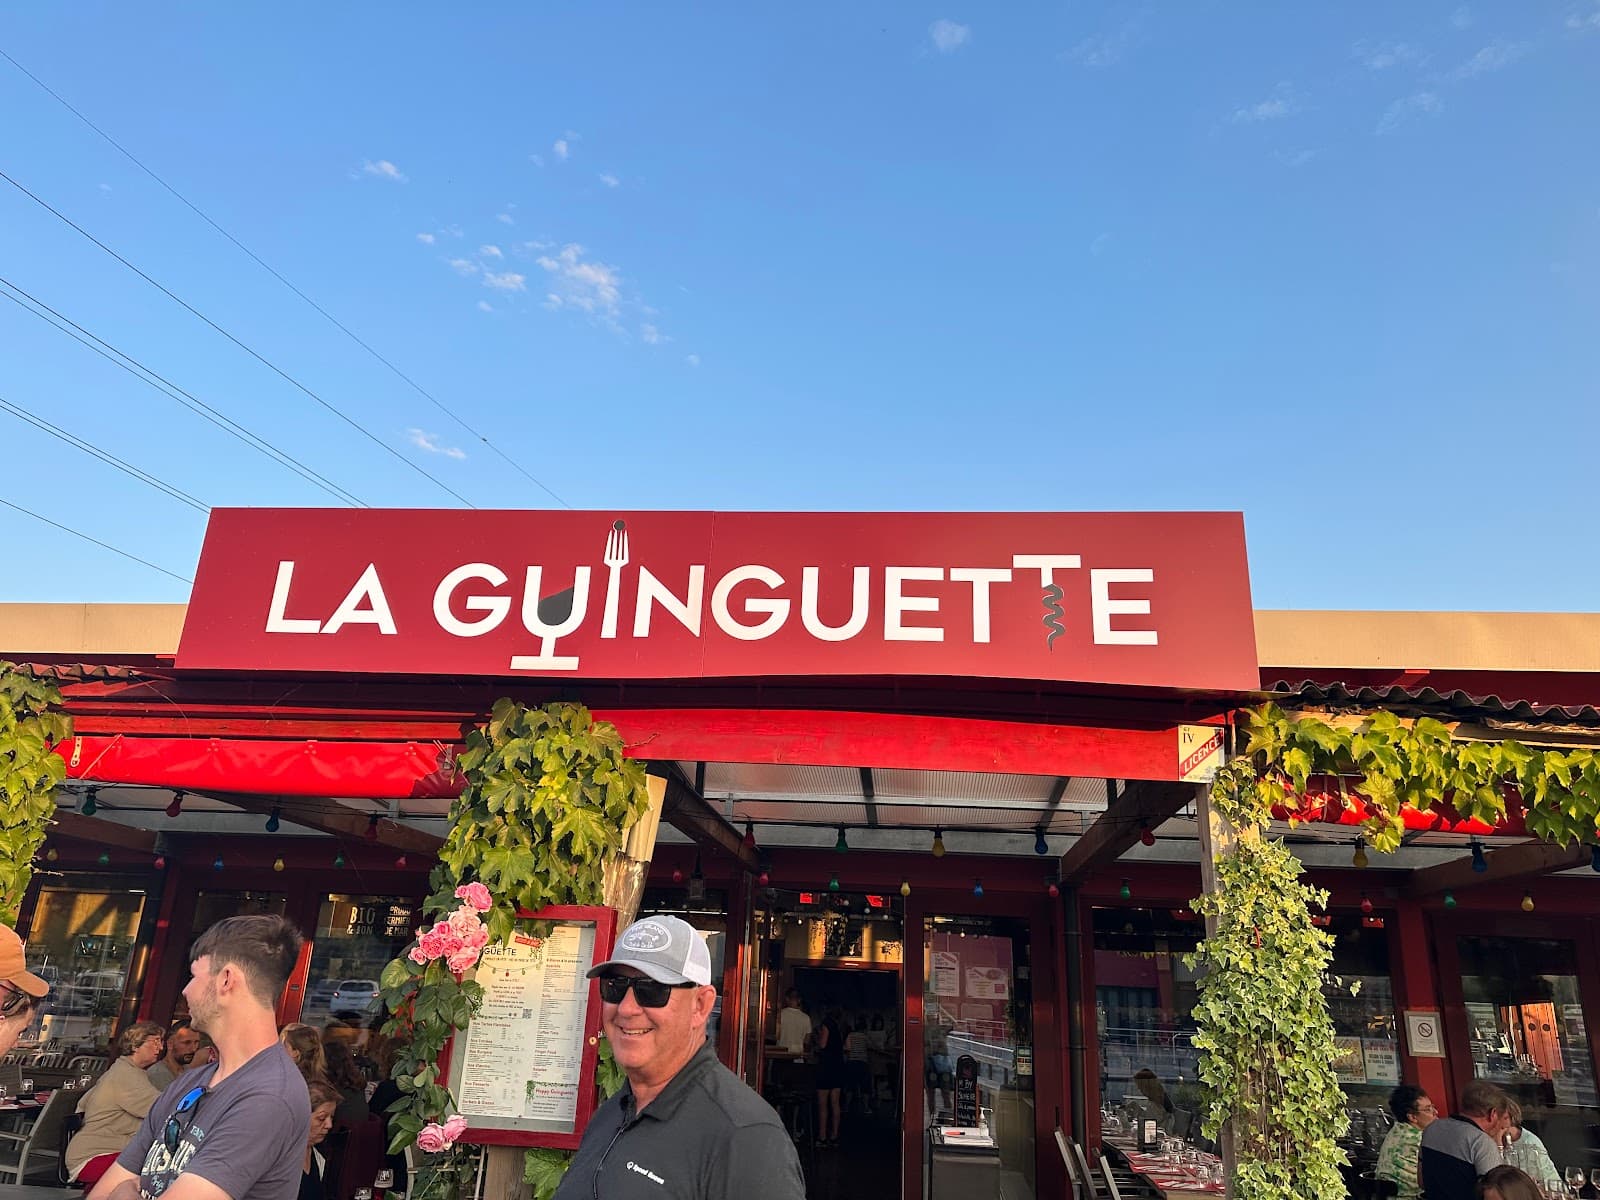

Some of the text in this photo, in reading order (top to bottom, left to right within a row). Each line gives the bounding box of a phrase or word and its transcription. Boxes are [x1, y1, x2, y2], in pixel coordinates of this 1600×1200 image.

[265, 519, 1159, 671] LA GUINGUETTE
[1184, 734, 1220, 772] LICENCE
[350, 906, 376, 925] BIO
